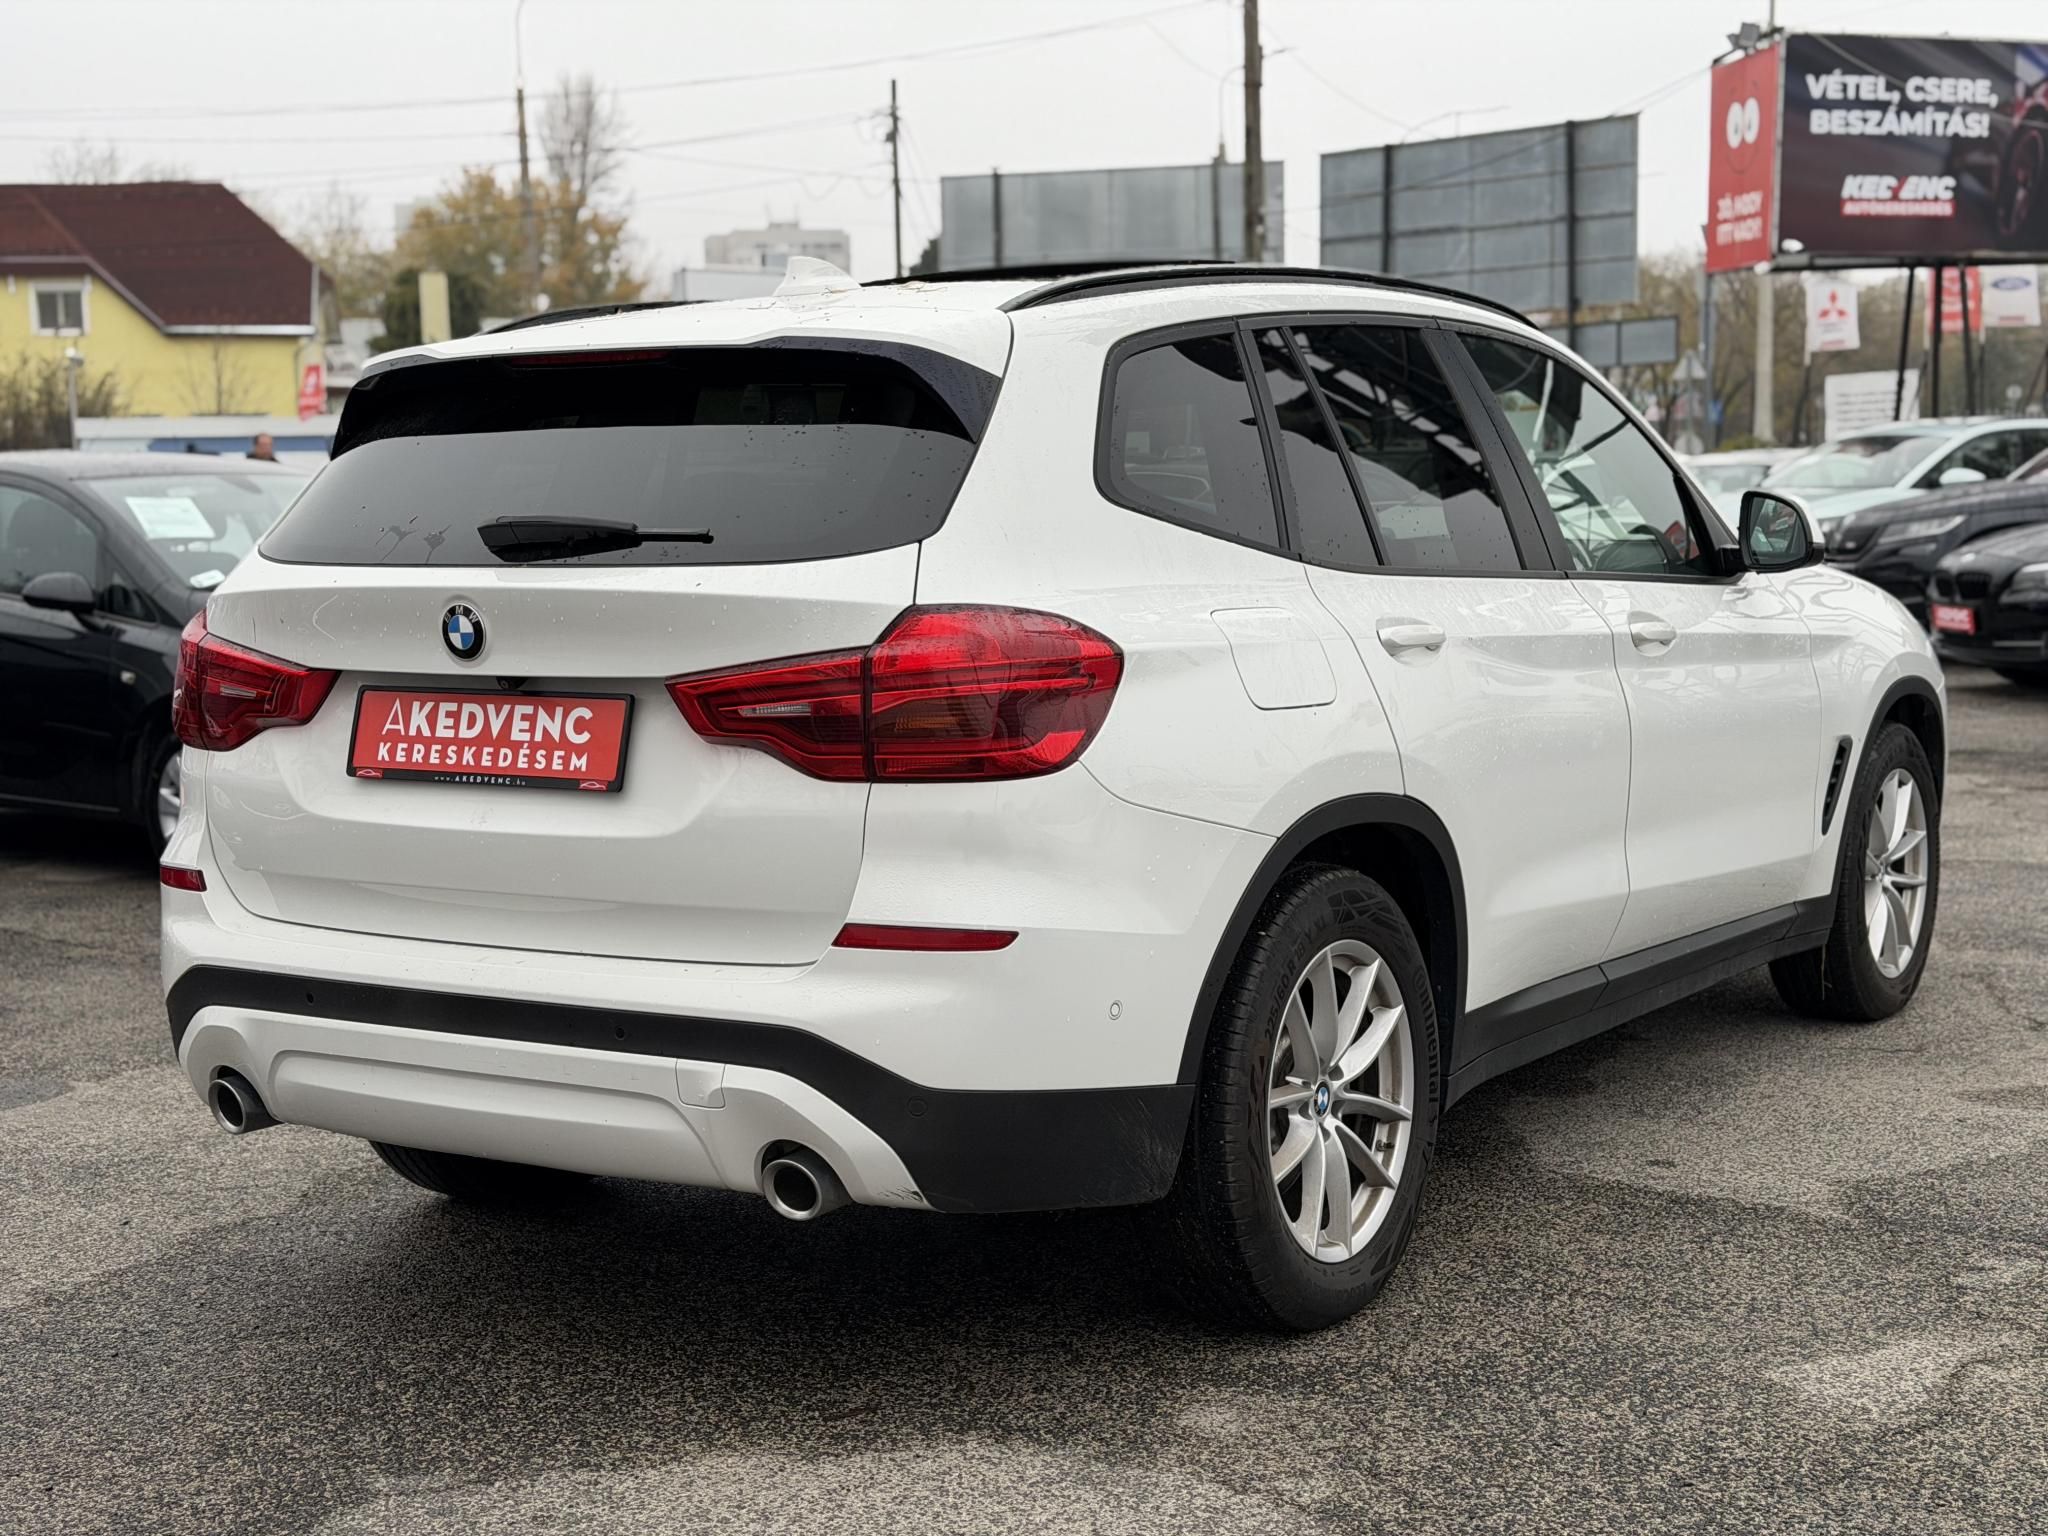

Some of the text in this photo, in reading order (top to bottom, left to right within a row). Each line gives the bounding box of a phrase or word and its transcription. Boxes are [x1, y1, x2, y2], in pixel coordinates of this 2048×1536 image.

[1805, 69, 1998, 108] VÉTEL, CSERE,
[1809, 105, 1991, 138] BESZÁMÍTÁS!
[444, 605, 479, 624] BMW
[381, 698, 594, 745] AKEDVENC
[377, 742, 589, 772] KERESKEDÉSEM
